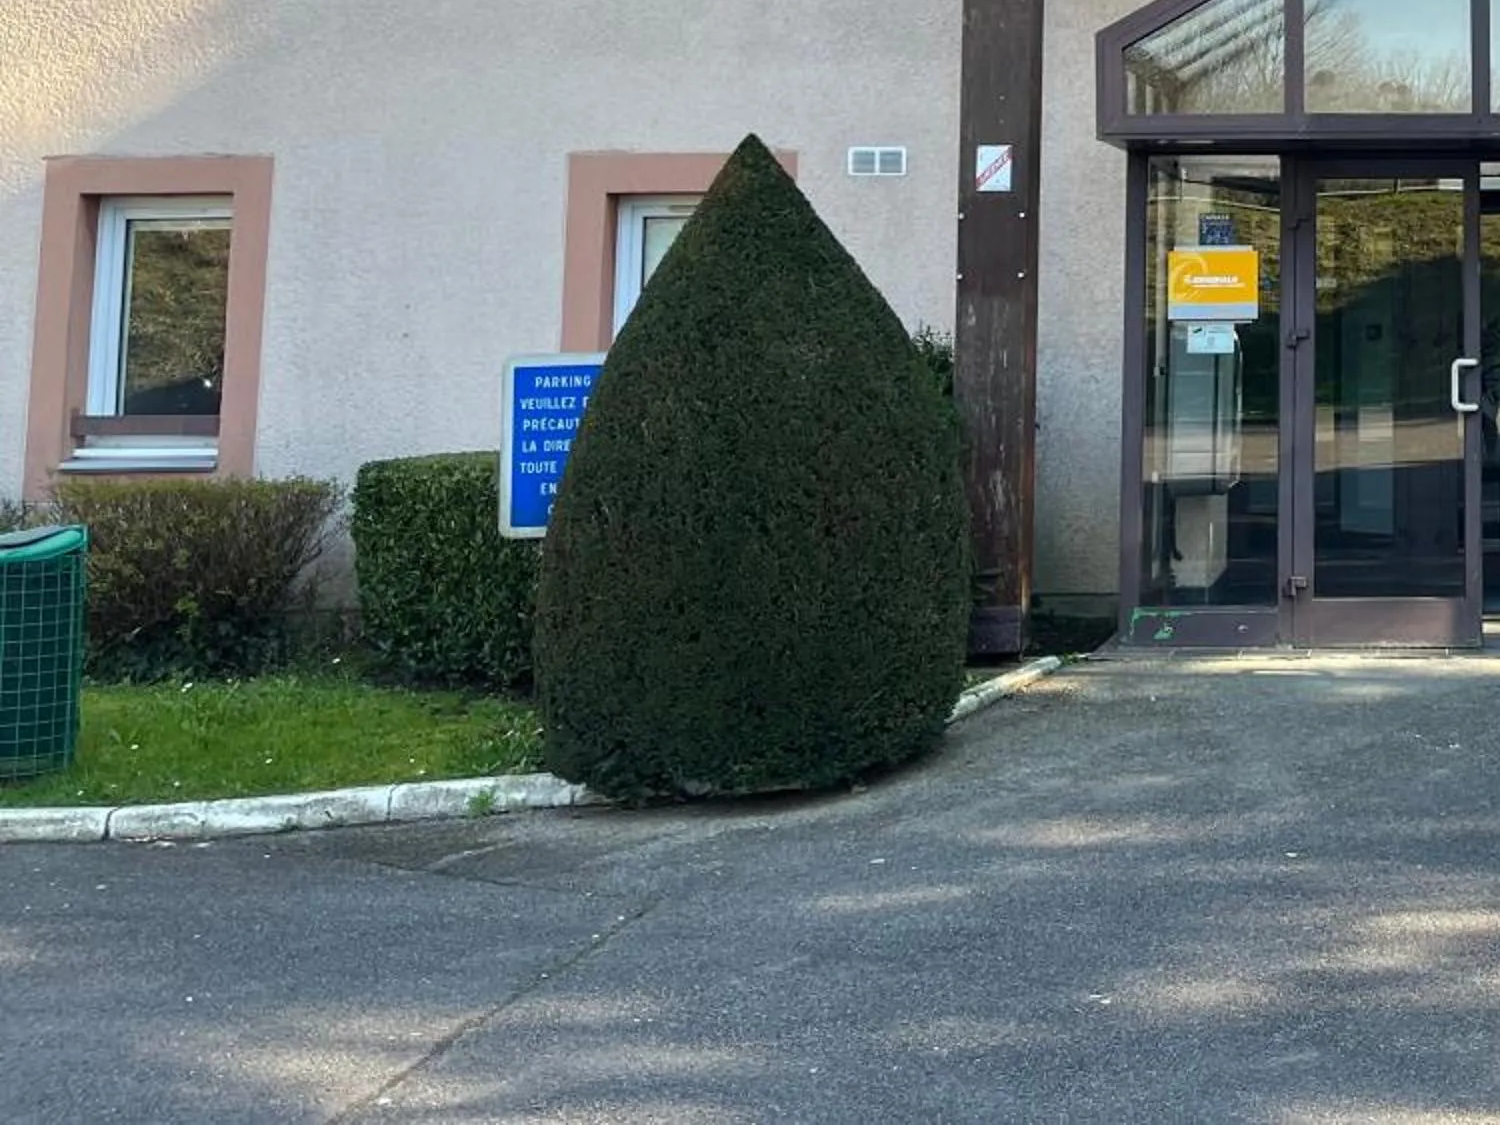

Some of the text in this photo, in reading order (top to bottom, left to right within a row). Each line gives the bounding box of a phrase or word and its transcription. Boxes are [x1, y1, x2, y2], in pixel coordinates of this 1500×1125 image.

[535, 375, 591, 388] PARKING
[520, 396, 576, 410] VEUILLEZ
[521, 440, 537, 453] LA
[520, 461, 557, 474] TOUTE
